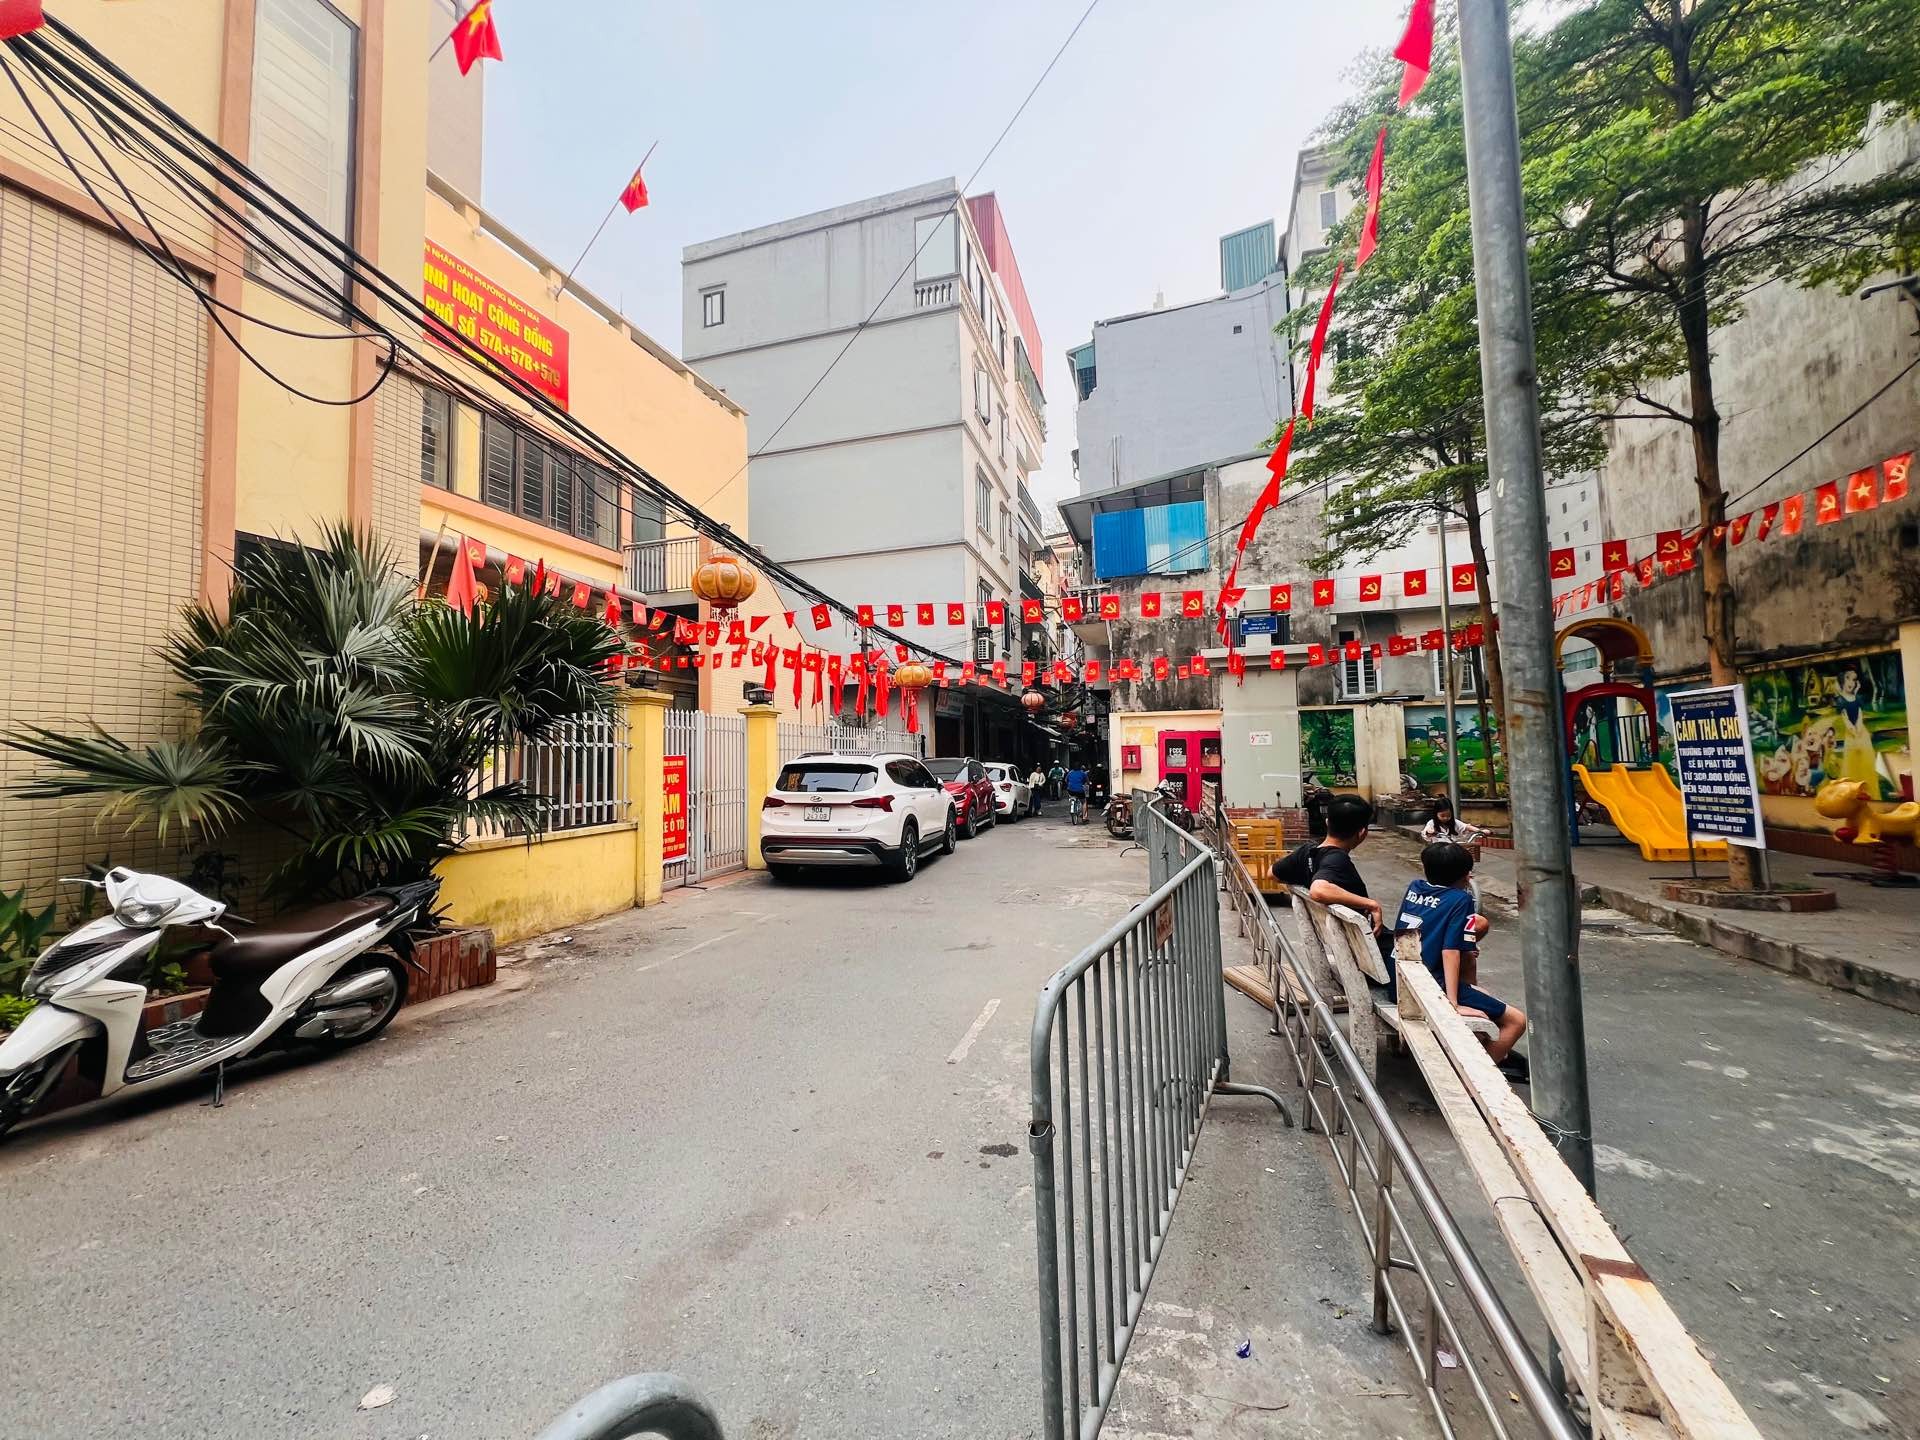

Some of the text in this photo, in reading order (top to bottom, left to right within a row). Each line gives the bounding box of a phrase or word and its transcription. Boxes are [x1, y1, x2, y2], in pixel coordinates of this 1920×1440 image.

[451, 278, 485, 316] HOẠT
[488, 303, 520, 337] CỘNG
[523, 326, 553, 358] ĐỒNG
[457, 312, 477, 339] SỐ
[1676, 713, 1697, 742] CẤM
[1698, 711, 1719, 741] THẢ
